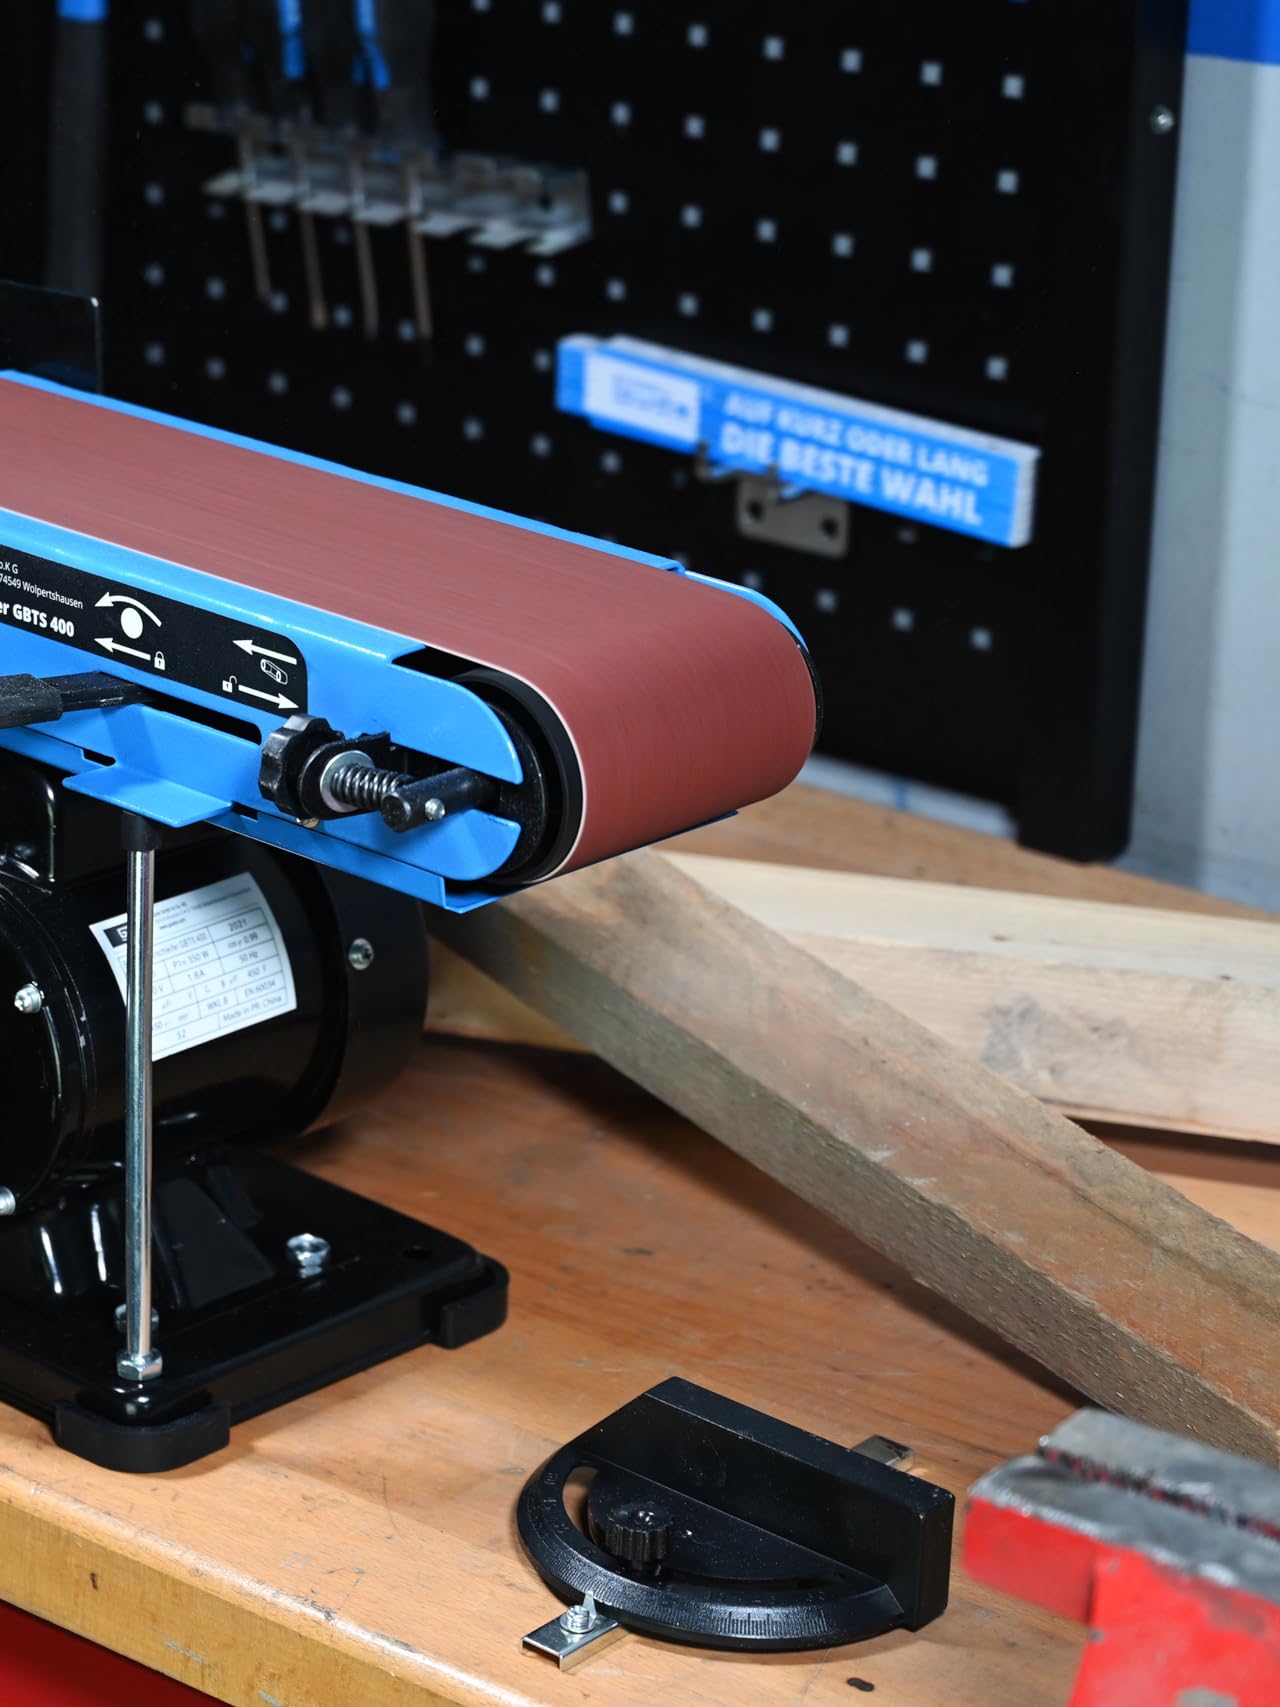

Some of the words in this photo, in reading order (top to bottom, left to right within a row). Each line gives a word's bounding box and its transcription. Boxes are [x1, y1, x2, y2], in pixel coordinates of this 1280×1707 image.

[722, 421, 774, 464] DIE
[780, 437, 875, 495] BESTE
[881, 467, 984, 526] WAHL
[846, 425, 913, 465] ODER
[916, 444, 989, 487] LANG
[22, 581, 84, 610] Wolpertshausen
[12, 603, 48, 628] GBTS
[49, 616, 75, 638] 400
